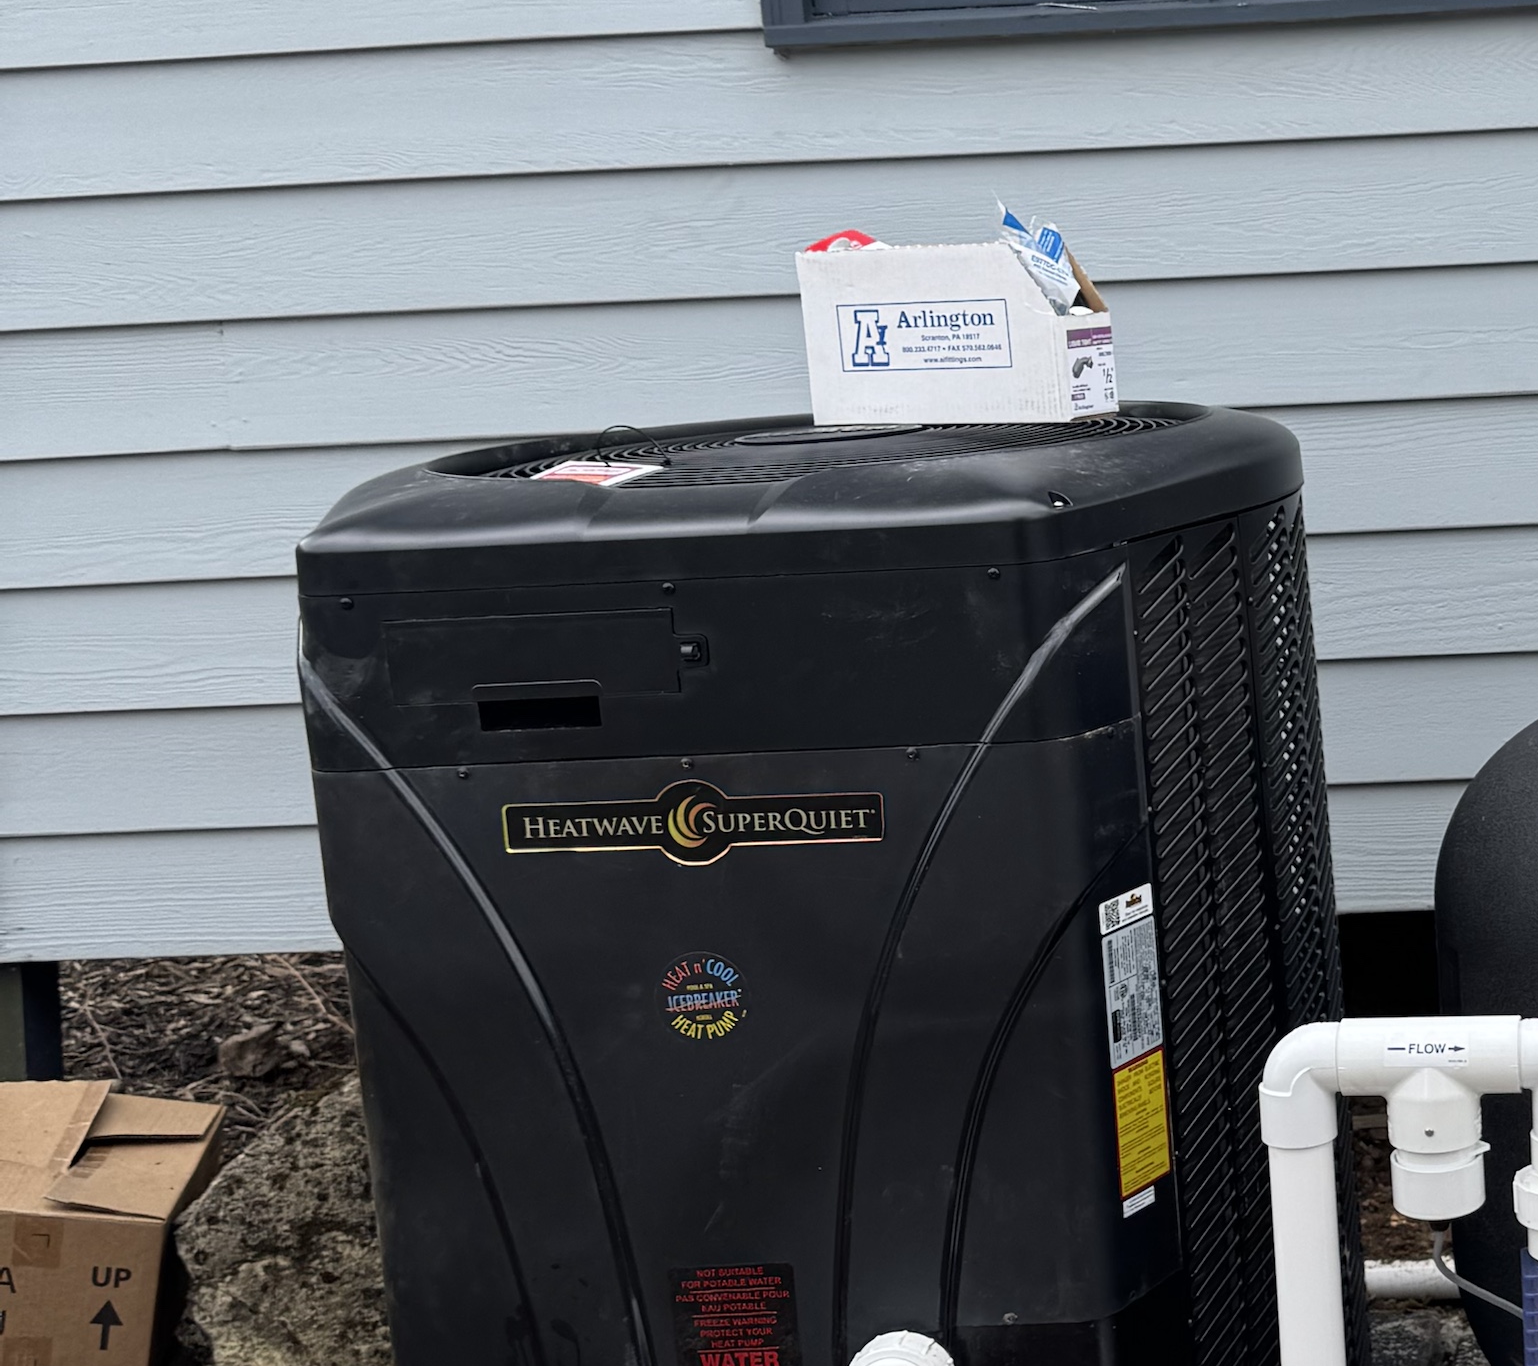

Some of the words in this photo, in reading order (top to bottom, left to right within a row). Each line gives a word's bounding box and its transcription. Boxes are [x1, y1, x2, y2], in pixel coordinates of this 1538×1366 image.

[897, 310, 996, 331] Arlington
[523, 815, 664, 839] HEATWAVE
[702, 808, 870, 835] SUPERQUIET
[662, 961, 691, 991] HEAT
[706, 959, 739, 986] COOL
[667, 990, 739, 1012] ICEBREAKER
[671, 1014, 704, 1040] HEAT
[705, 1010, 739, 1040] PUMP
[1408, 1043, 1446, 1054] FLOW
[92, 1266, 132, 1288] UP
[696, 1269, 715, 1277] NOT
[719, 1267, 763, 1276] SUITABLE
[681, 1281, 700, 1289] FOR
[703, 1278, 746, 1288] POTABLE
[749, 1277, 782, 1286] WATER
[676, 1294, 694, 1302] PAS
[763, 1290, 790, 1299] POUR
[723, 1302, 766, 1312] POTABLE
[694, 1319, 731, 1327] FREEZE
[732, 1316, 777, 1325] WARNING
[700, 1328, 743, 1338] PROTECT
[746, 1327, 773, 1336] YOUR
[711, 1340, 735, 1348] HEAT
[738, 1338, 764, 1347] PUMP
